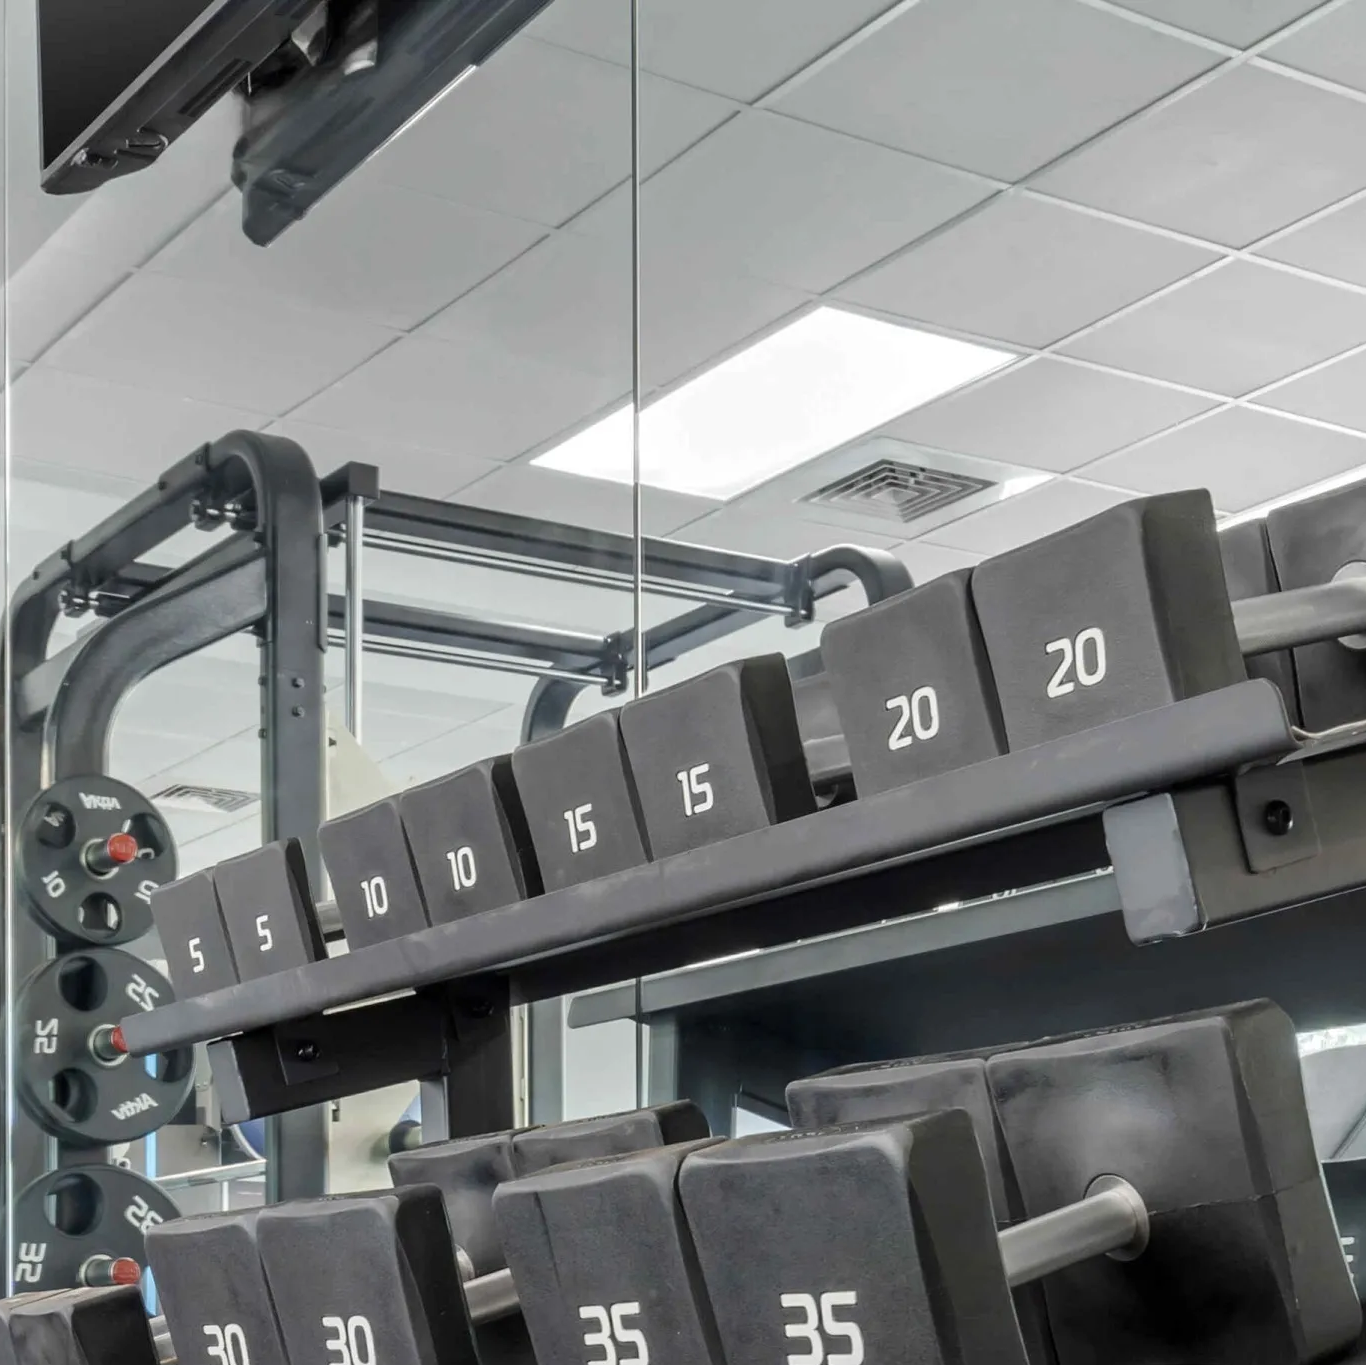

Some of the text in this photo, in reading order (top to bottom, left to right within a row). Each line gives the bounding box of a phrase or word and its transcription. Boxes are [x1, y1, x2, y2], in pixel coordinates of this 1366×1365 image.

[1044, 626, 1107, 698] 20
[885, 685, 940, 751] 20
[676, 762, 714, 817] 15
[563, 803, 598, 854] 15
[446, 845, 477, 891] 10
[360, 875, 389, 919] 10
[188, 937, 205, 974] 5
[255, 914, 273, 952] 5
